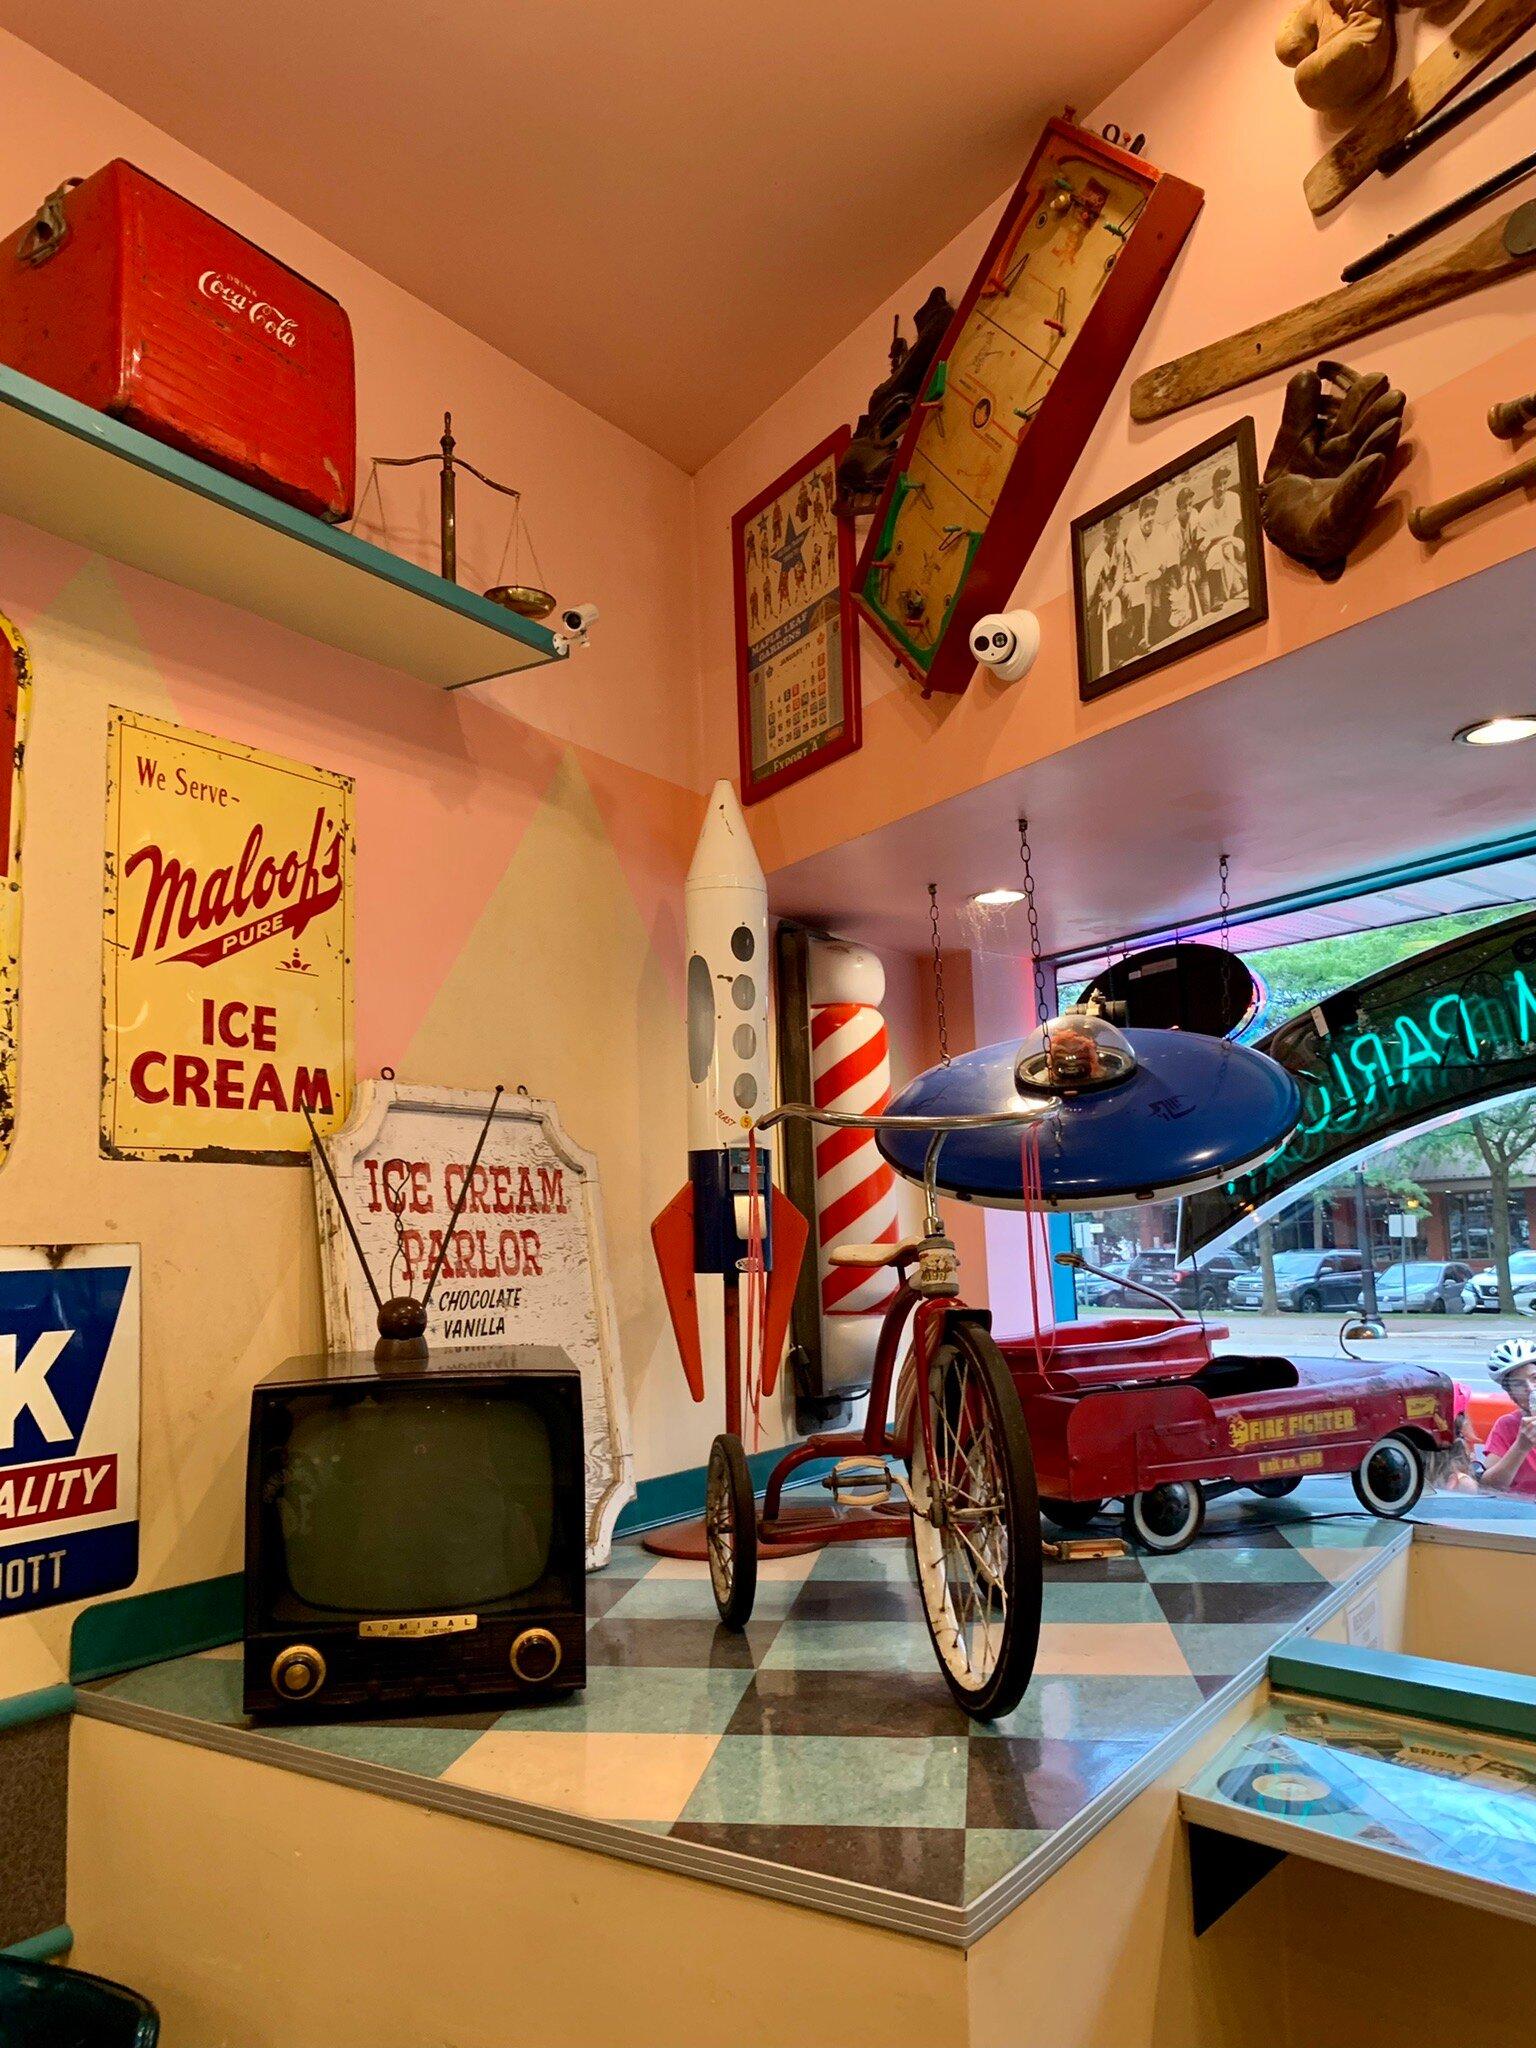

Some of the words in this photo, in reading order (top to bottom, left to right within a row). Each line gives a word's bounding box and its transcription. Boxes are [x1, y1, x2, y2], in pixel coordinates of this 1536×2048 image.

[198, 270, 299, 348] Coca-Cola
[136, 755, 167, 791] We
[125, 806, 344, 962] Maloof's
[221, 913, 284, 955] PURE
[201, 997, 278, 1053] ICE
[129, 1050, 335, 1116] CREAM
[363, 1158, 434, 1214] ICE
[444, 1162, 568, 1216] CREAM
[401, 1228, 544, 1281] PARLOR
[438, 1287, 523, 1312] CHOCOLATE
[443, 1316, 506, 1339] VANILLA
[1251, 1417, 1285, 1441] FIRE
[1288, 1409, 1356, 1437] FIGHTER
[0, 1549, 67, 1600] OTT
[366, 1618, 471, 1632] ADMIRAL
